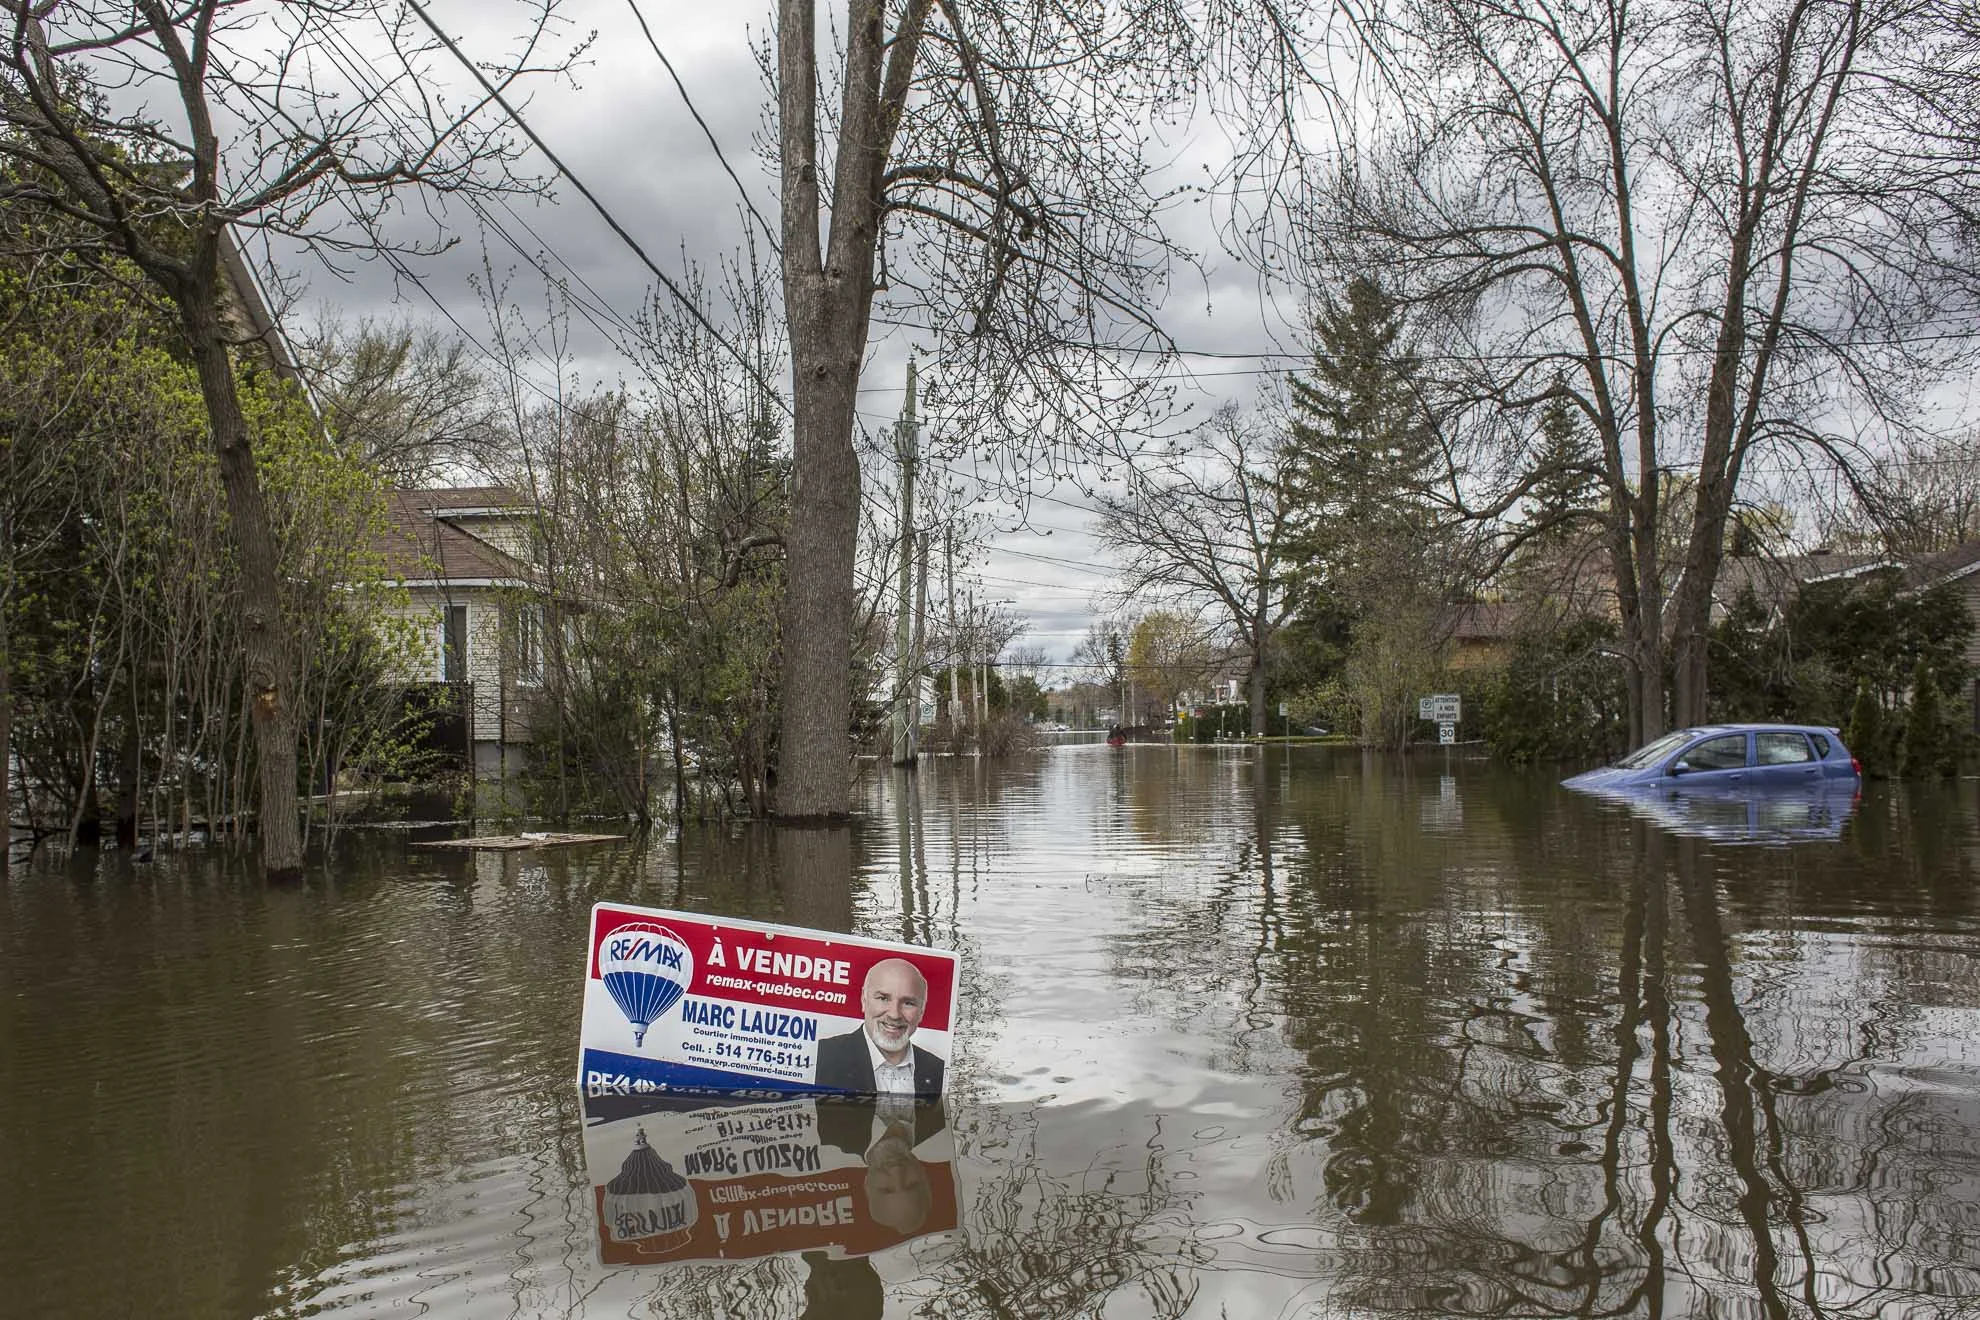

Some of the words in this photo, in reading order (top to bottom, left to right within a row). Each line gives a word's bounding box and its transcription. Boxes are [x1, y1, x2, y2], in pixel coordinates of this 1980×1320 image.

[1441, 729, 1453, 737] 30
[610, 937, 684, 972] RE/MAX
[707, 937, 726, 967] À
[736, 947, 851, 985] VENDRE
[706, 974, 847, 1004] remax-quebec.com
[682, 1000, 735, 1029] MARC
[741, 1009, 818, 1042] LAUZON
[693, 1027, 728, 1040] Courtier
[730, 1032, 776, 1046] immobilier
[777, 1040, 803, 1051] agréé
[682, 1042, 705, 1053] Cell.
[716, 1042, 742, 1058] 514
[746, 1047, 811, 1069] 776-5111
[688, 1055, 803, 1079] remaxvrp.com/marc-lauzon
